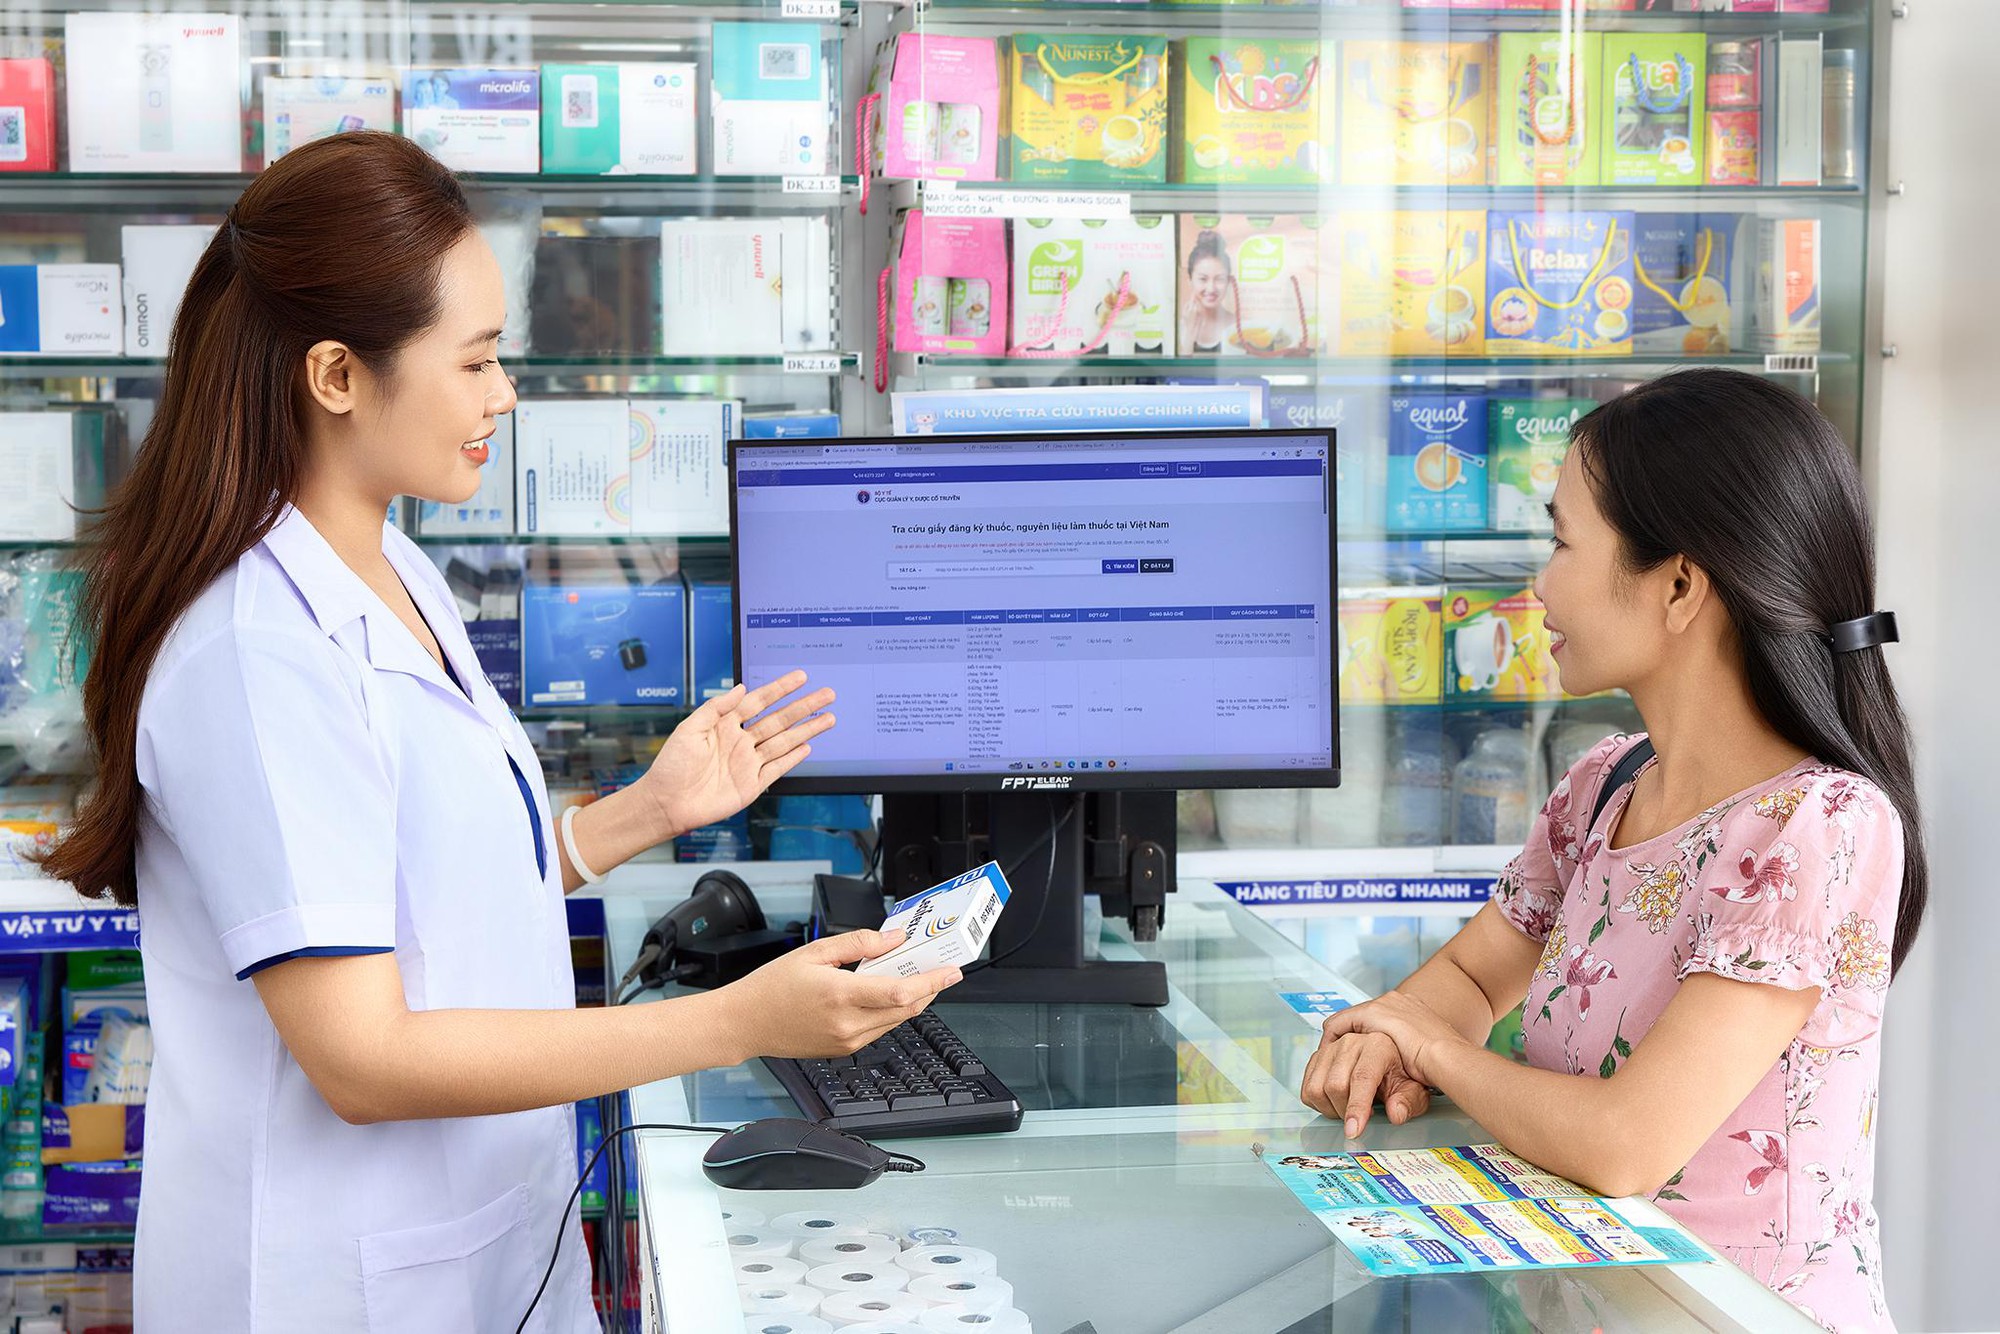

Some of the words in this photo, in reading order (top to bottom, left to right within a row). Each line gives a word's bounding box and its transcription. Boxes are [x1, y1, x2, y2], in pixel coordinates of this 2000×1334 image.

[786, 3, 834, 15] DK.2.1.4
[480, 80, 530, 93] microlife
[787, 179, 835, 191] DK.2.1.5
[1096, 196, 1122, 205] SODA
[1530, 248, 1588, 270] Relax
[64, 332, 110, 344] microlife
[788, 359, 836, 371] DK.2.1.6
[944, 409, 975, 419] KHU
[981, 408, 1012, 420] VỰC
[1016, 408, 1047, 418] TRA
[1409, 400, 1469, 430] equal
[1502, 406, 1515, 416] 40
[1516, 408, 1580, 441] equal
[908, 524, 926, 533] cứu
[928, 523, 946, 534] giấy
[949, 524, 971, 534] đăng
[974, 524, 984, 534] ký
[986, 521, 1014, 532] thuốc,
[1016, 522, 1049, 533] nguyên
[1052, 521, 1068, 532] liệu
[1070, 521, 1086, 530] làm
[1089, 520, 1114, 530] thuốc
[1116, 521, 1128, 532] tại
[1130, 520, 1147, 532] Việt
[1150, 520, 1169, 529] Nam
[1406, 608, 1420, 683] TROPICANA
[1001, 778, 1036, 790] FPT
[1236, 882, 1290, 900] HÀNG
[1295, 882, 1337, 900] TIÊU
[1342, 881, 1397, 899] DÙNG
[1402, 883, 1470, 898] NHANH
[2, 915, 47, 939] VẬT
[52, 915, 85, 934] TƯ
[89, 917, 106, 932] Y
